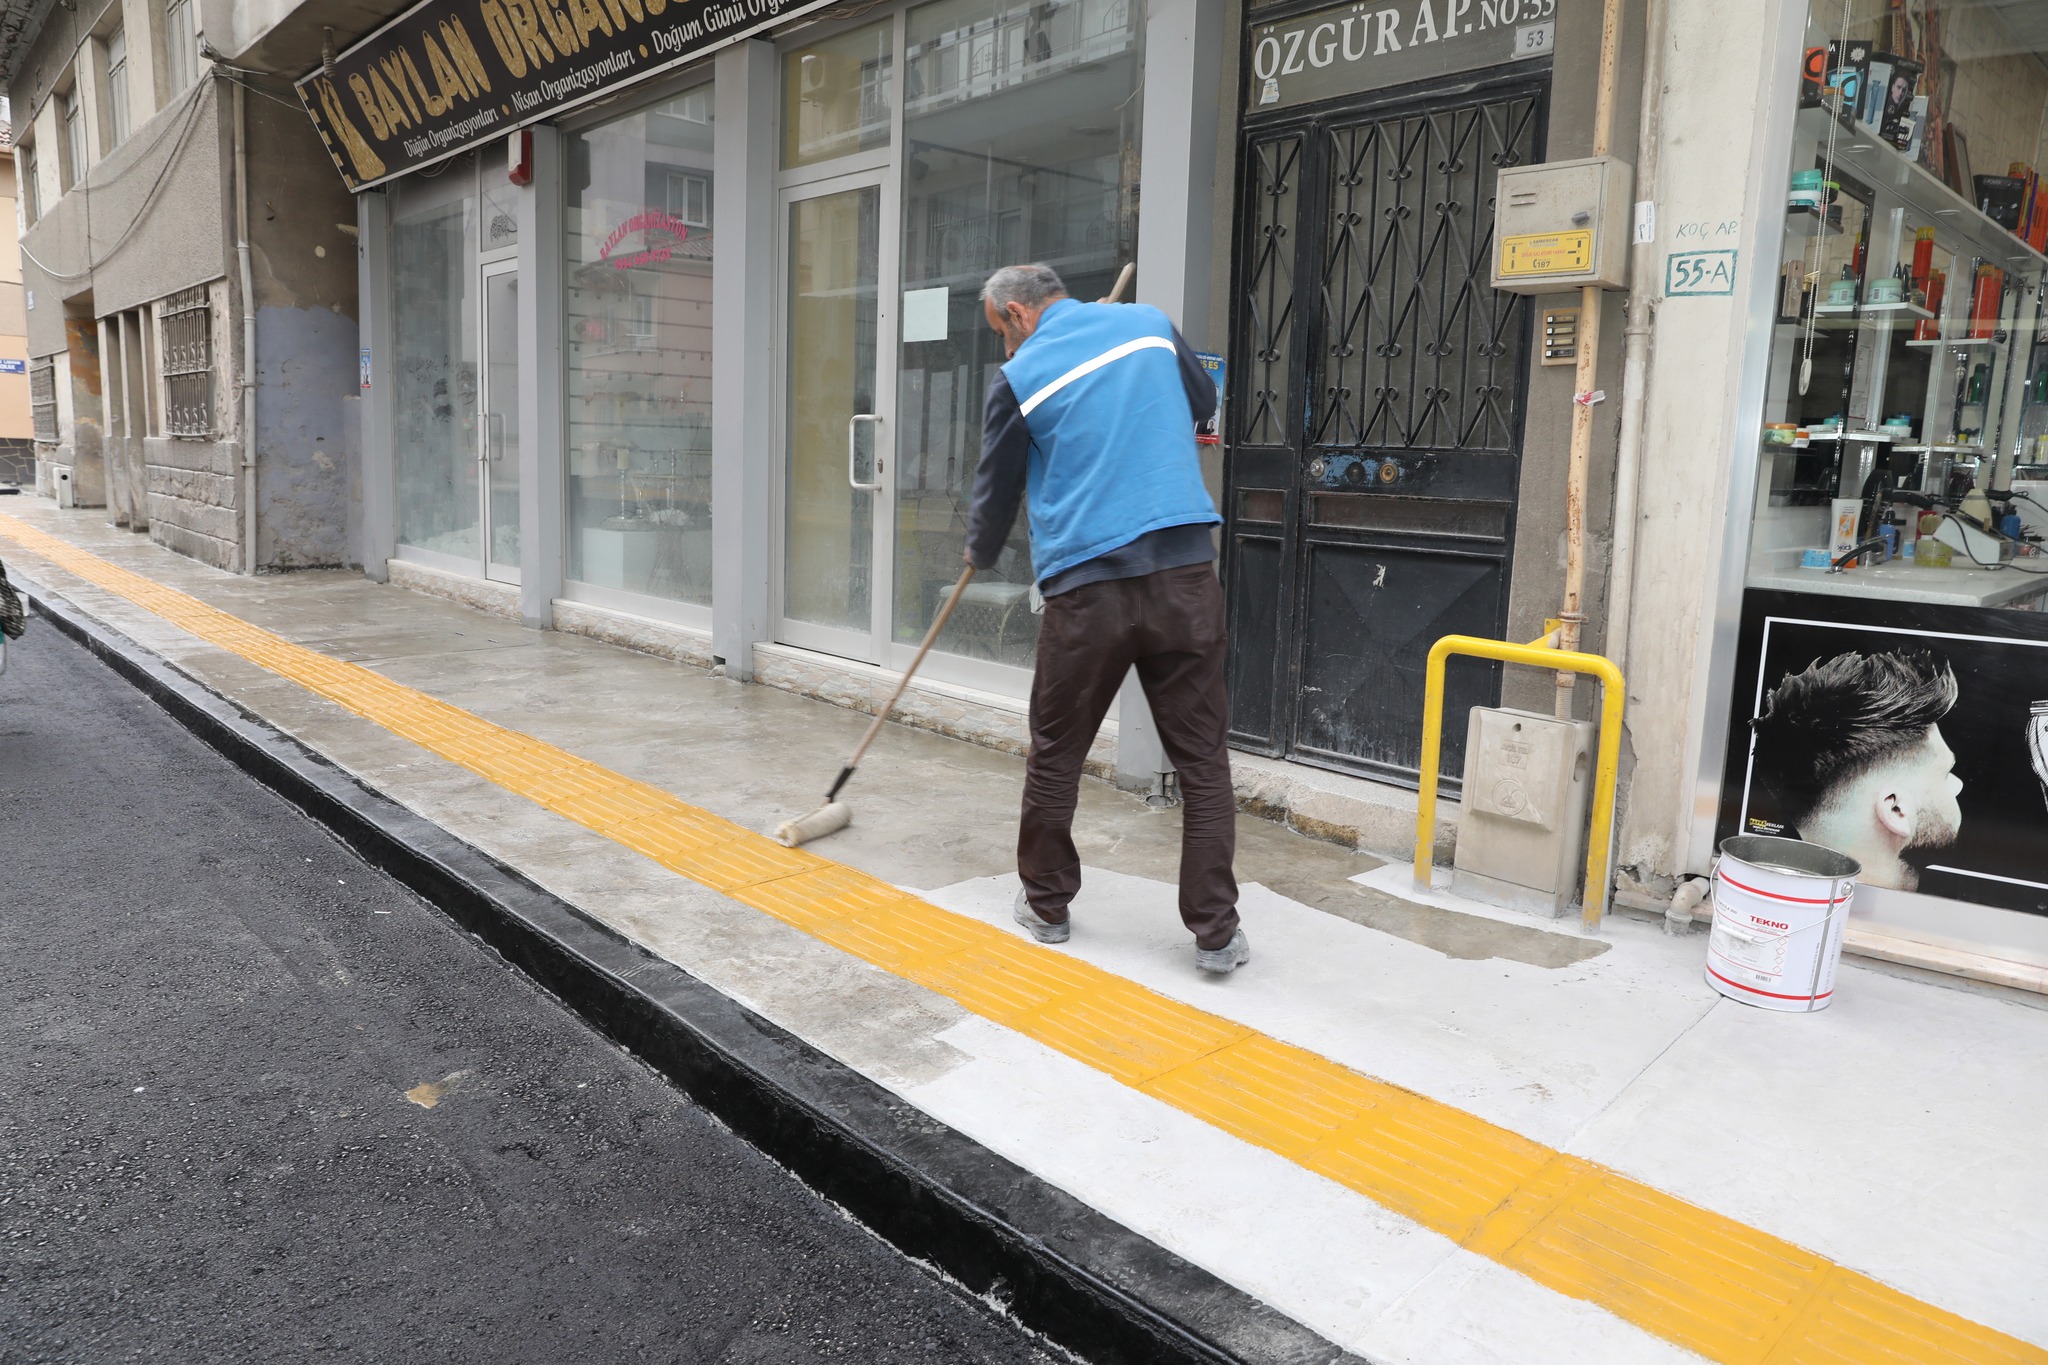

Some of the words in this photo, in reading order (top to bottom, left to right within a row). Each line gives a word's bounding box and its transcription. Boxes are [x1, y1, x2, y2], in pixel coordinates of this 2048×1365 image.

[1254, 3, 1402, 80] ÖZGÜR
[1526, 30, 1545, 48] 53
[349, 13, 492, 141] BAYLAN
[403, 135, 431, 158] Düğün
[428, 108, 500, 147] Organizasyonları
[511, 88, 543, 112] Nişan
[540, 49, 635, 101] Organizasyonları
[651, 24, 704, 54] Doğum
[703, 0, 747, 32] Günü
[1676, 222, 1710, 240] KOÇ
[1674, 259, 1729, 287] 55-A
[1750, 915, 1790, 930] TEKNO
